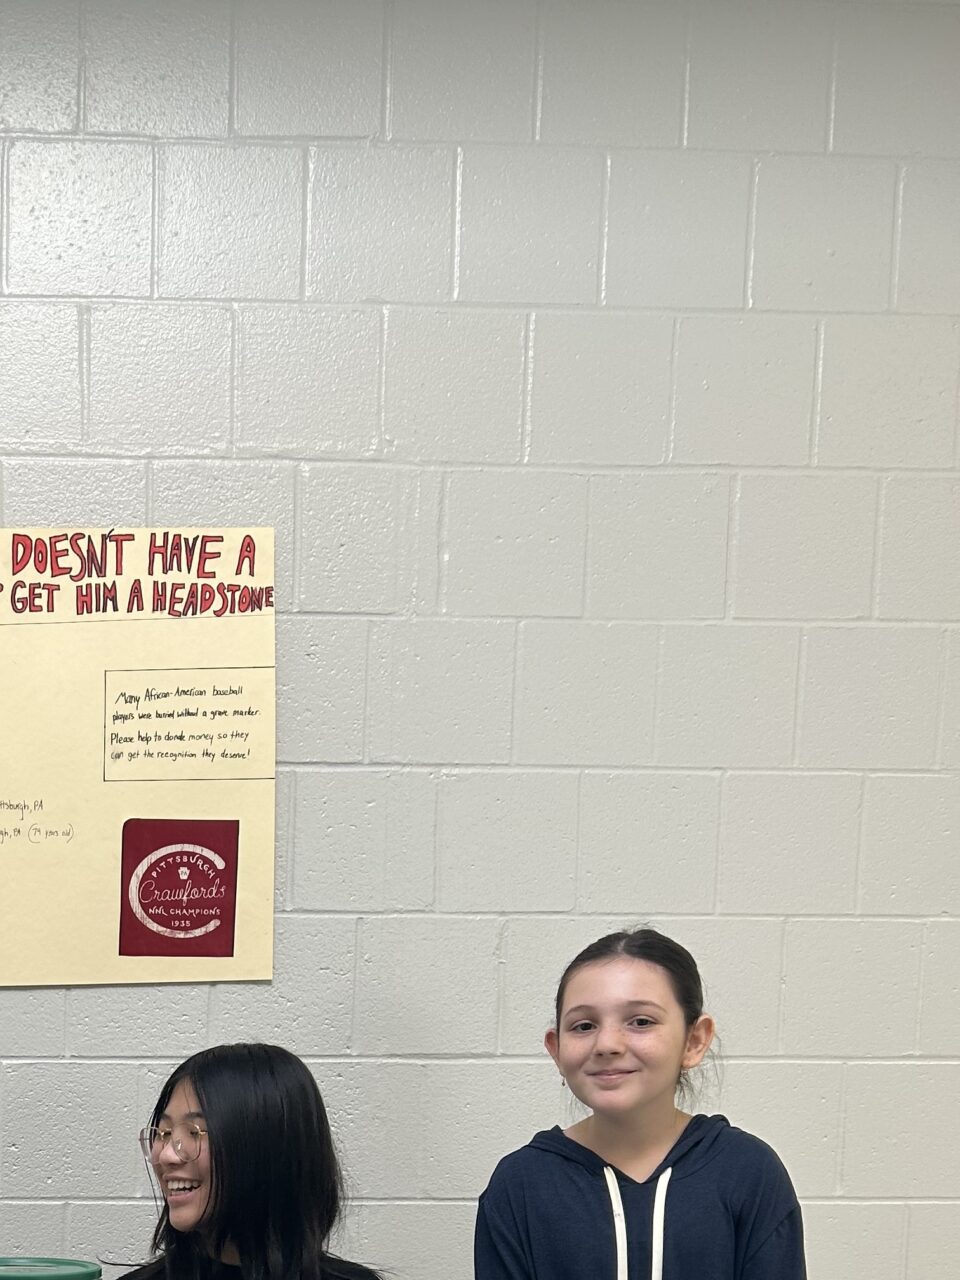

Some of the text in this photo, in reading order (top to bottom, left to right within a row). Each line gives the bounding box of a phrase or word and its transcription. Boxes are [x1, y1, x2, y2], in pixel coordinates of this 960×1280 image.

[148, 532, 224, 579] HAVE
[235, 534, 256, 577] A
[11, 580, 60, 613] GET
[76, 580, 119, 614] HIM
[127, 579, 144, 613] A
[153, 581, 275, 617] HEADSTONE
[115, 692, 141, 710] Many
[212, 685, 243, 697] baseball
[112, 710, 135, 725] players
[138, 712, 152, 720] were
[210, 710, 228, 720] grave
[110, 732, 135, 745] Please
[137, 731, 152, 745] help
[154, 731, 162, 742] to
[164, 730, 186, 742] donate
[188, 734, 214, 746] money
[231, 731, 249, 743] they
[111, 748, 250, 763] can get the recognition they deserve!
[151, 855, 215, 879] PITTSBURGH
[140, 878, 226, 906] Crawfords
[148, 906, 221, 917] NNL CHAMPIONS
